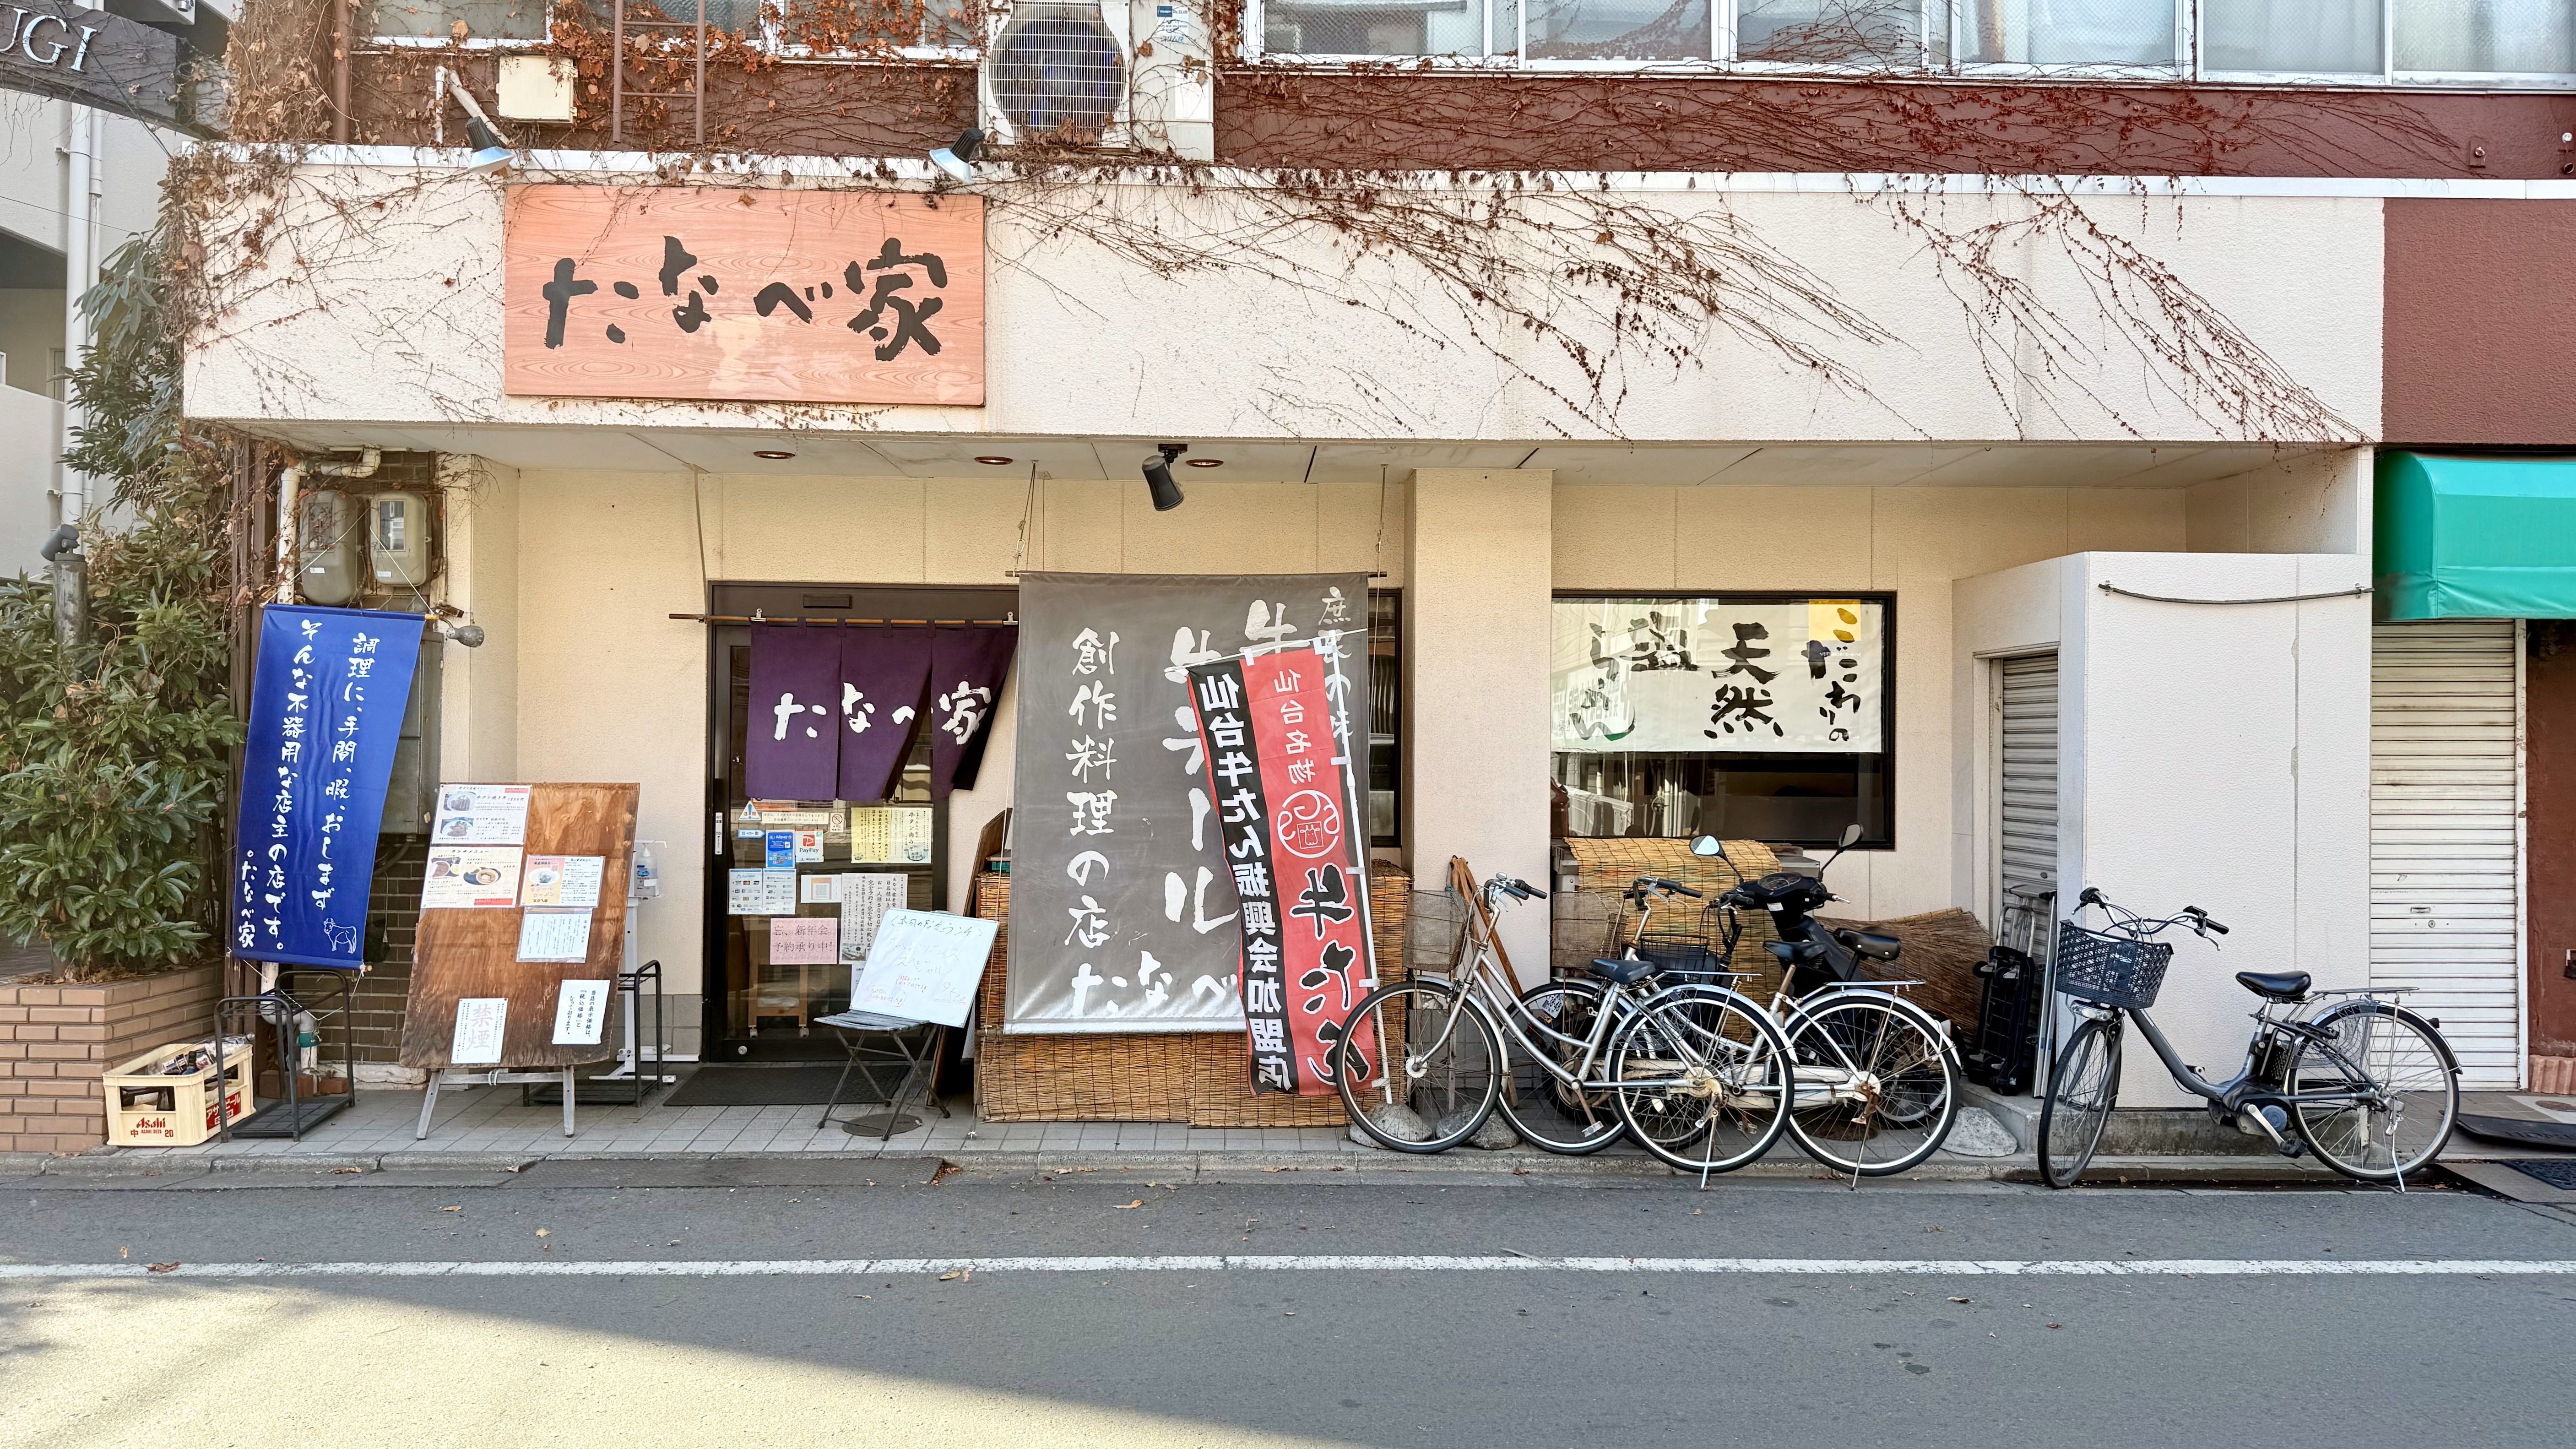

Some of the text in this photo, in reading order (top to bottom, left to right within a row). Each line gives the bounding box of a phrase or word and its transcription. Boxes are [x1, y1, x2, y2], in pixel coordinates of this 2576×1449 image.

[542, 235, 947, 361] たなべ家
[1703, 622, 1783, 739] 天然
[1065, 626, 1120, 948] 創作料理の店
[773, 924, 828, 936] 忘、新年会
[772, 941, 832, 952] 予約承り中!
[466, 1003, 493, 1051] 禁煙
[206, 1093, 241, 1120] アサビール
[130, 1129, 139, 1138] 中
[165, 1129, 174, 1138] 20
[136, 1117, 166, 1129] Asahi
